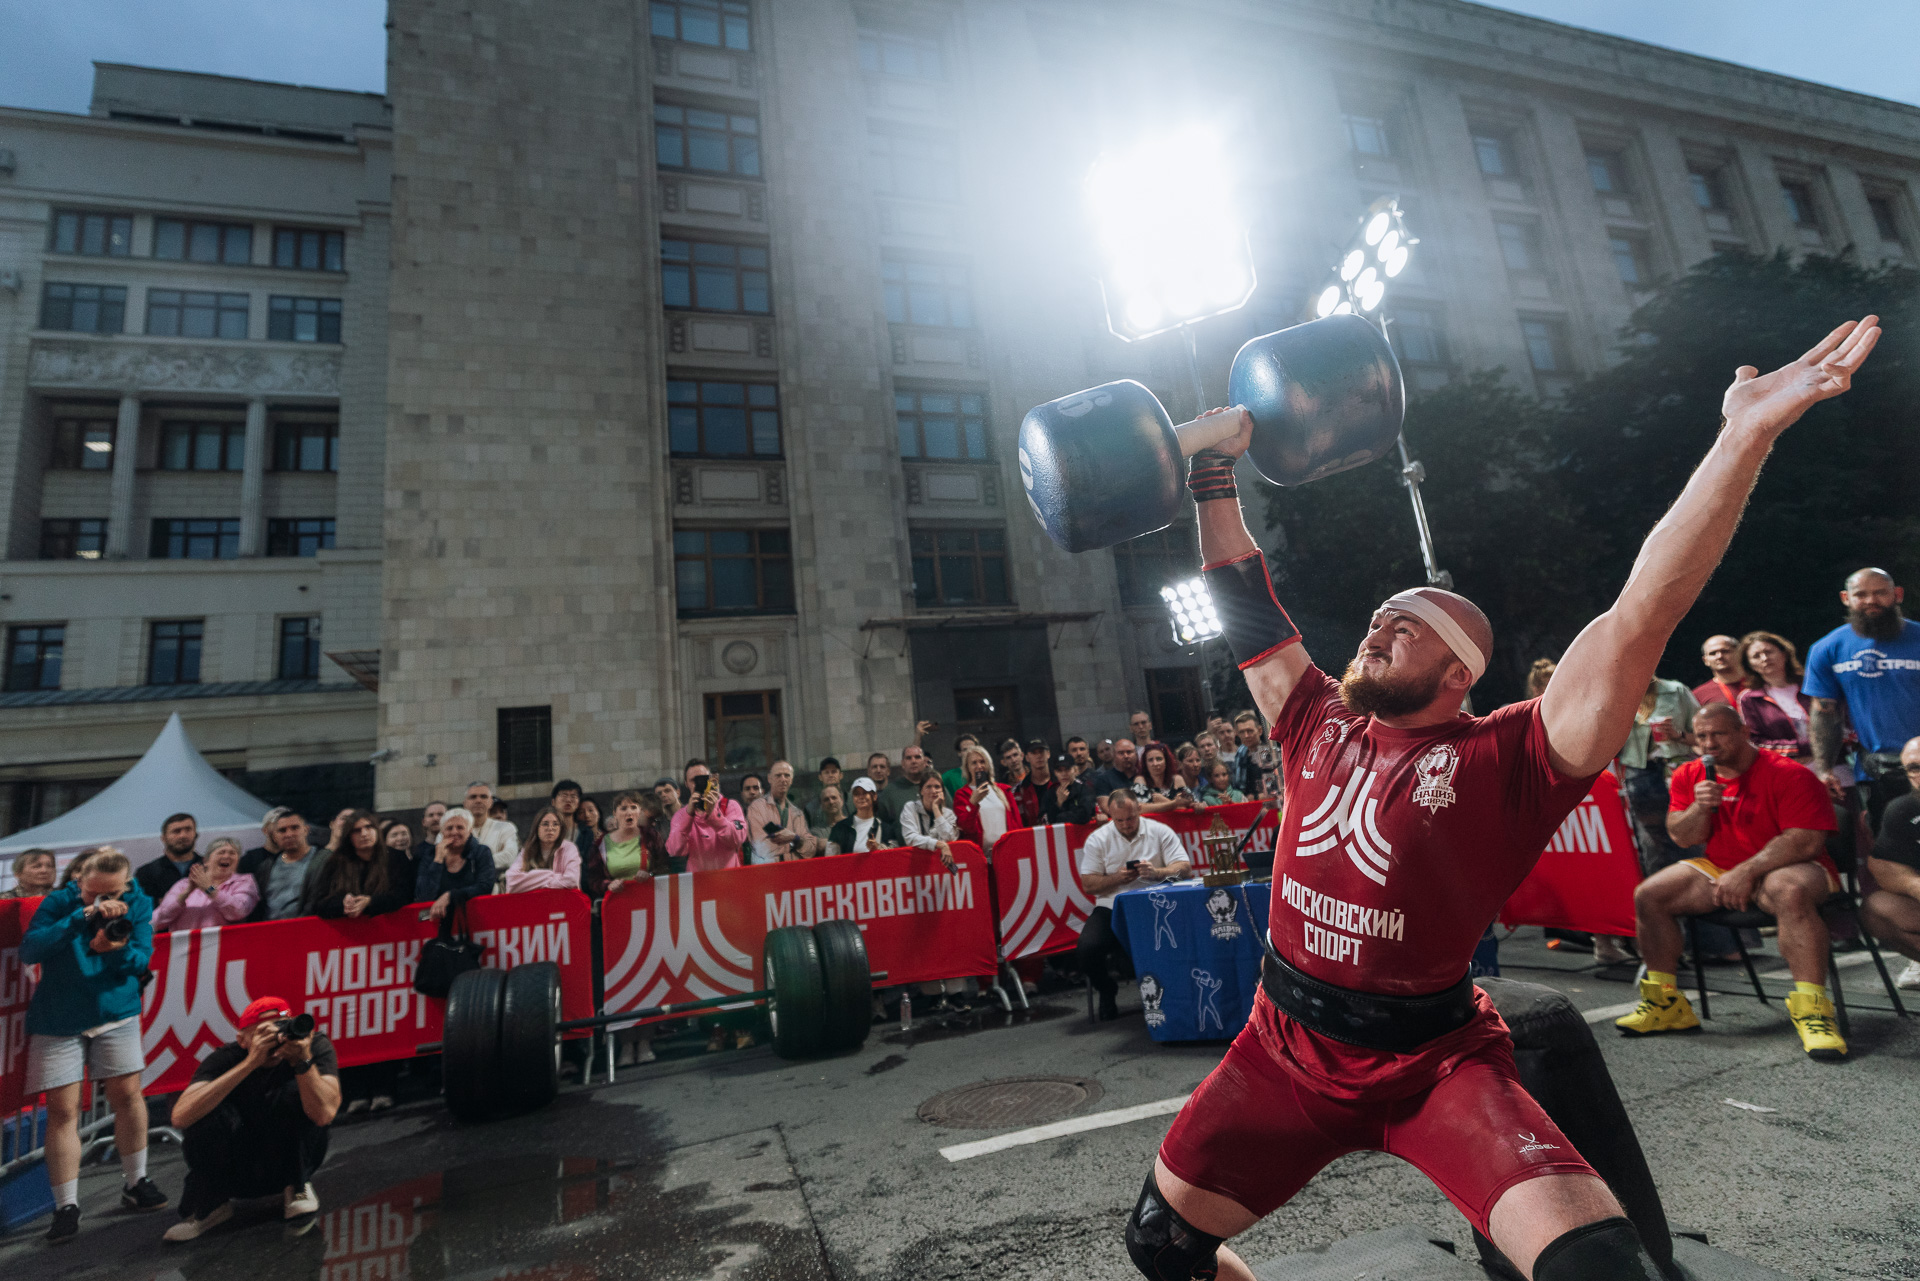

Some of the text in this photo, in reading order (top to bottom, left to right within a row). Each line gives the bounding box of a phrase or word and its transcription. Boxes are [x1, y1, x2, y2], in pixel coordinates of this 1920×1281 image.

[1414, 789, 1454, 801] НАЦИЯ
[1422, 797, 1447, 806] МИРА
[765, 863, 974, 932] МОСКОВСКИЙ
[1281, 872, 1405, 942] МОСКОВСКИЙ
[305, 912, 572, 996] МОСКСКИЙ
[1303, 920, 1363, 966] СПОРТ
[304, 986, 427, 1041] СПОРТ
